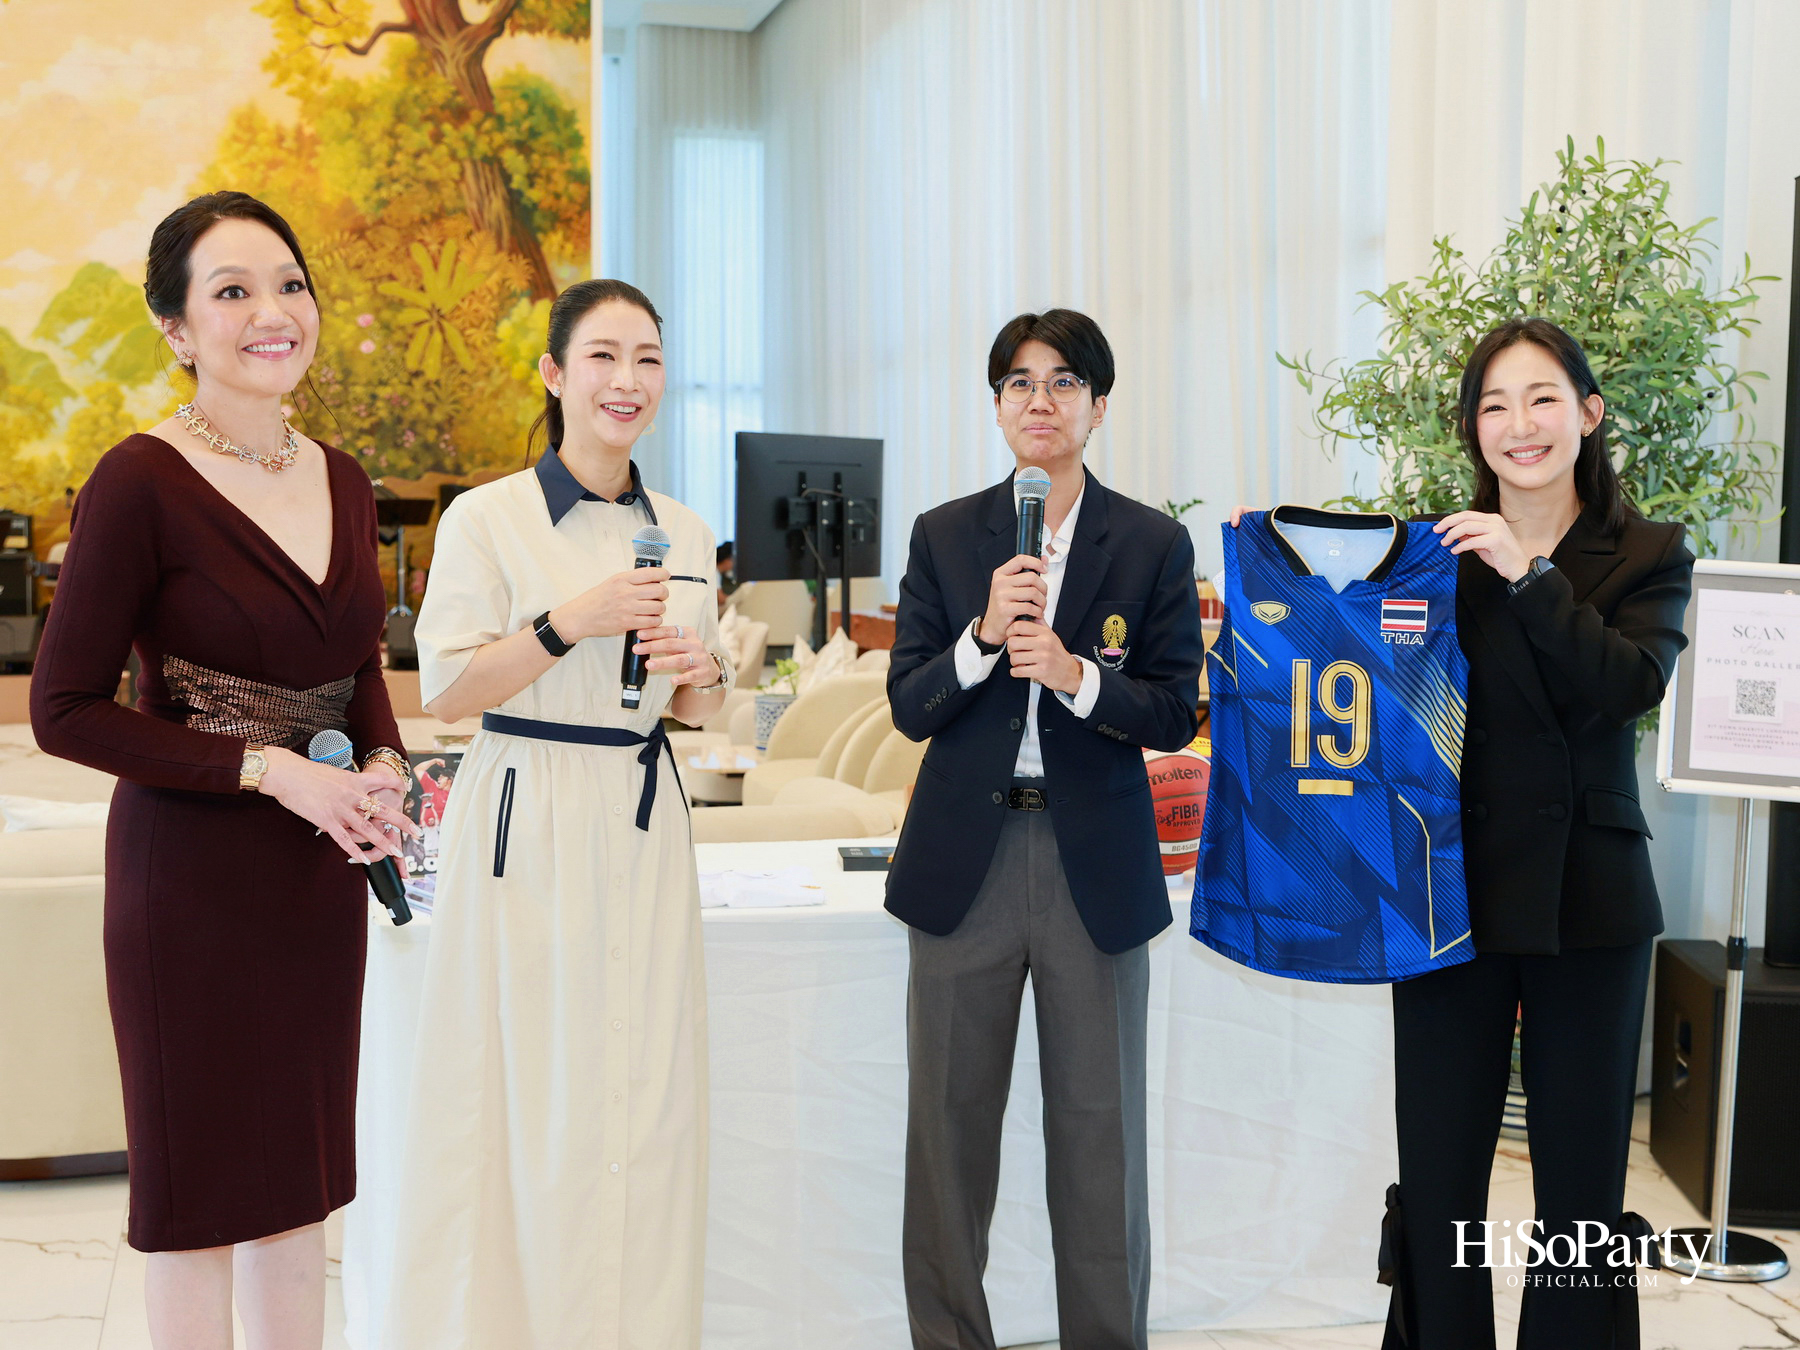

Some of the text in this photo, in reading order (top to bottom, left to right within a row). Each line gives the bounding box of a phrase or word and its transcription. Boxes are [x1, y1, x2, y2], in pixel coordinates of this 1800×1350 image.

[1380, 631, 1425, 646] THA
[1732, 624, 1787, 640] SCAN
[1706, 657, 1748, 666] PHOTO
[1290, 658, 1372, 769] 19
[1171, 803, 1200, 821] FIBA
